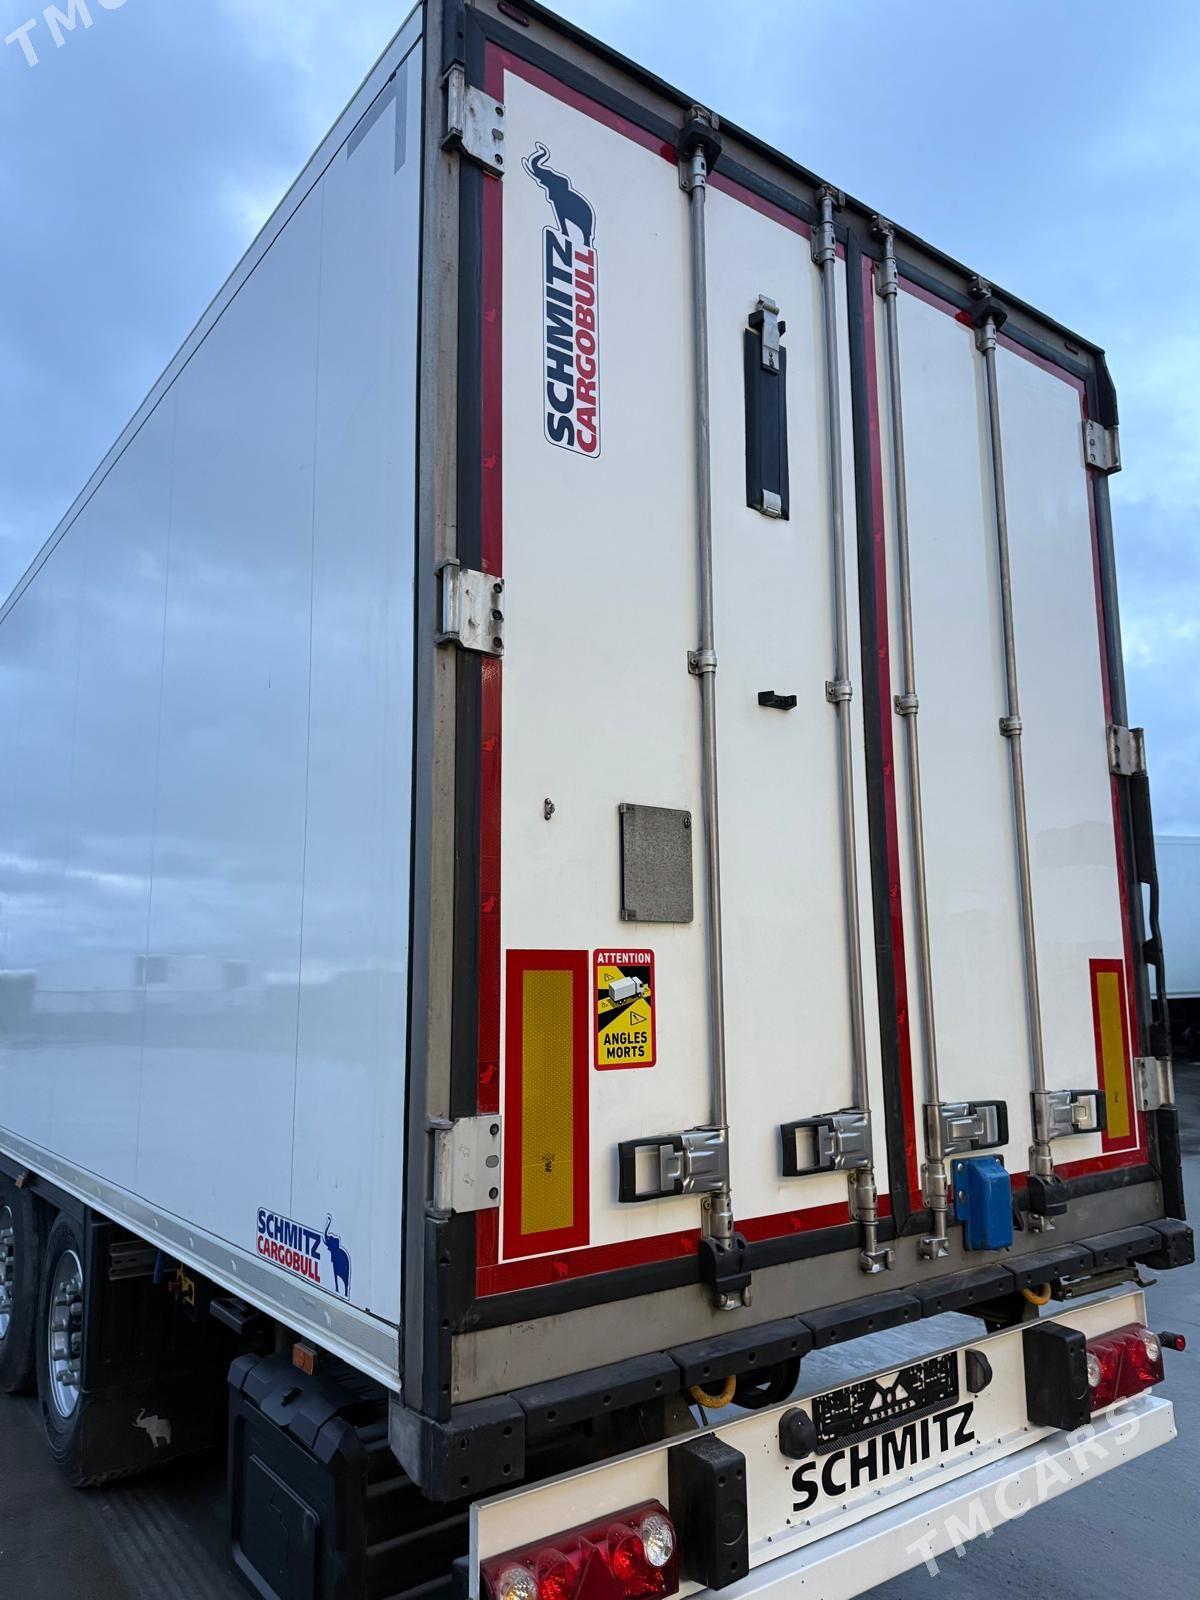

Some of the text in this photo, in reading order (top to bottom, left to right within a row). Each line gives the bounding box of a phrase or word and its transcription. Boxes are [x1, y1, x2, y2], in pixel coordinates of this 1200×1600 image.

[546, 229, 575, 447] SCHMITZ
[575, 249, 597, 453] CARGOBULL
[597, 952, 651, 964] ATTENTION
[603, 1031, 648, 1046] ANGLES
[606, 1045, 645, 1059] MORTS
[257, 1235, 321, 1284] CARGOBULL
[258, 1209, 321, 1261] SCHMITZ
[790, 1401, 976, 1513] SCHMITZ
